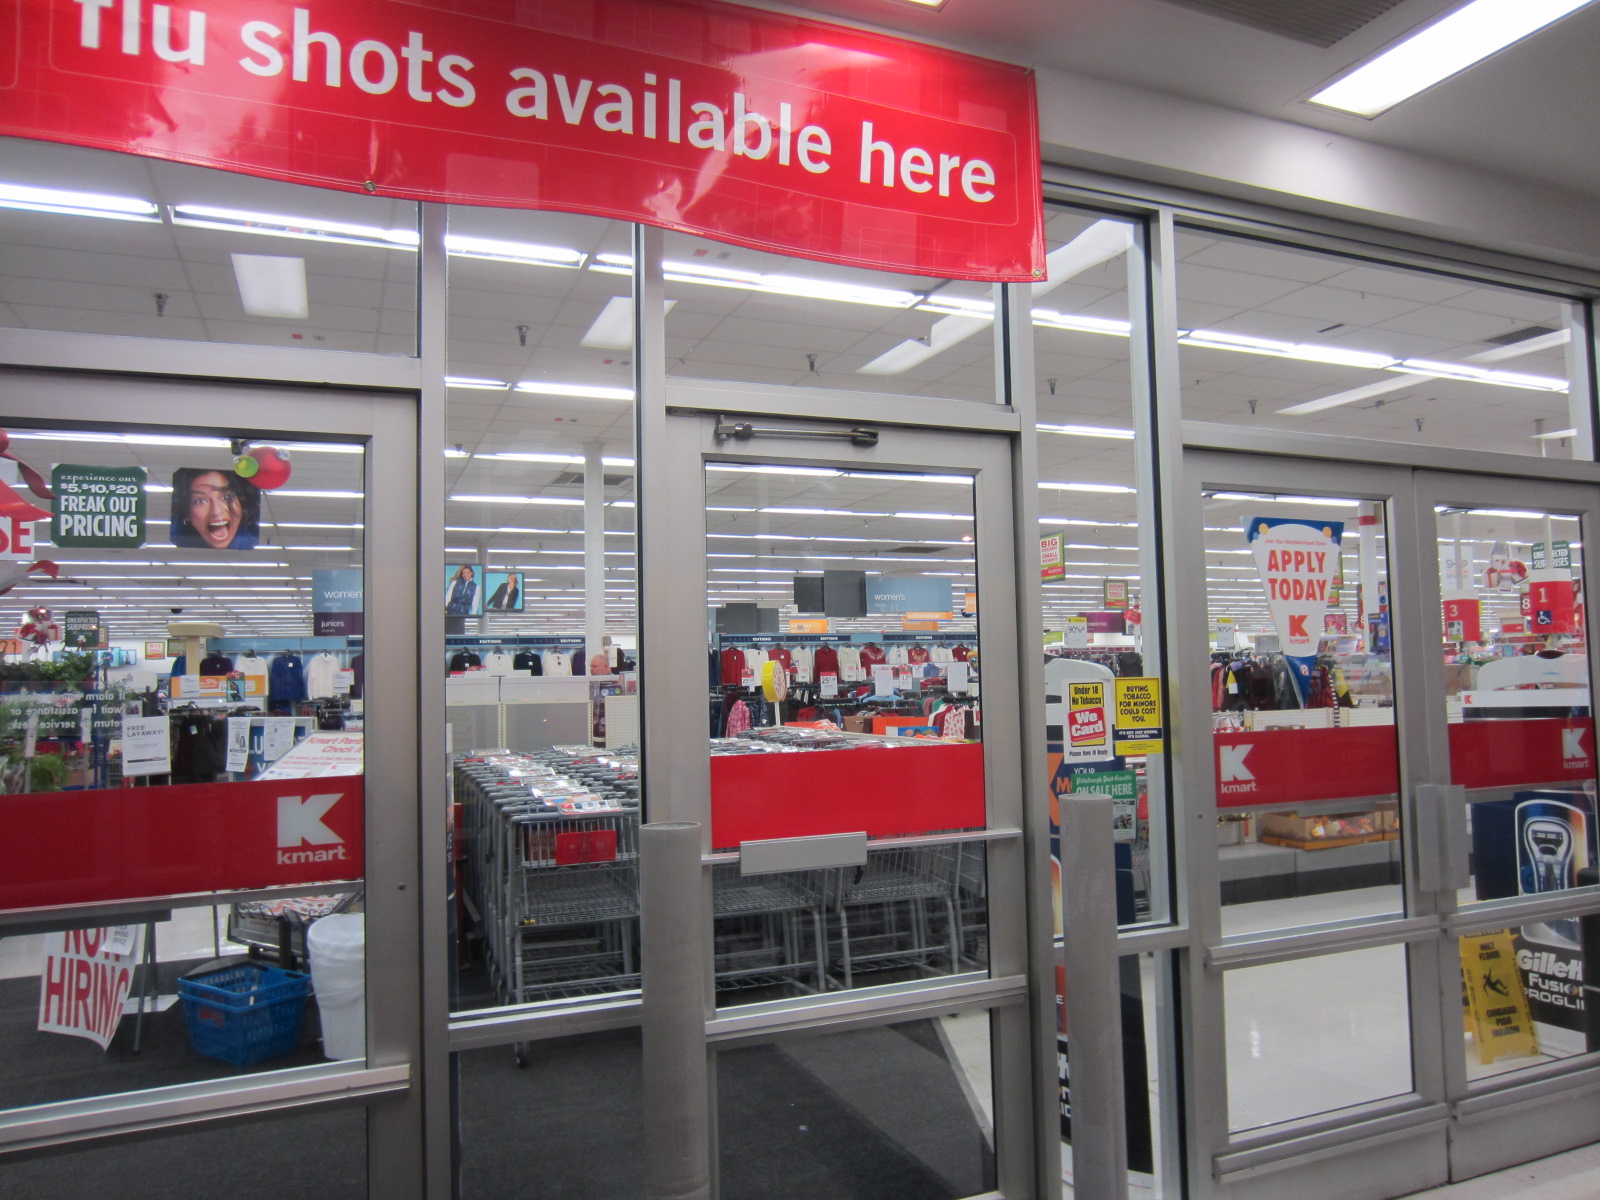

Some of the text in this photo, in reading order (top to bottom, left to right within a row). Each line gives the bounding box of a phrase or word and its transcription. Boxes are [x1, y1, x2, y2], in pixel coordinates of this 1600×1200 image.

[73, 0, 996, 204] flu shots available here
[61, 473, 115, 484] experience
[60, 495, 138, 513] FREAK OUT
[60, 515, 138, 537] PRICING
[1041, 538, 1058, 548] BIG
[1533, 549, 1568, 560] UNEECTED
[1267, 549, 1327, 574] APPLY
[1445, 559, 1468, 568] SHP
[1534, 557, 1569, 569] SURRISES
[1267, 577, 1327, 601] TODAY
[1538, 587, 1549, 603] 1
[874, 592, 906, 601] women's
[1521, 598, 1531, 610] 8
[1449, 604, 1458, 617] 3
[320, 619, 345, 629] juniors
[1288, 614, 1310, 637] K
[1073, 685, 1099, 695] Under 18
[1126, 685, 1149, 693] BUYING
[1071, 696, 1102, 706] No Tobacco
[1074, 711, 1099, 724] We
[1120, 707, 1156, 716] COULD COST
[1131, 715, 1146, 723] YOU.
[1071, 720, 1104, 737] Card
[306, 736, 338, 745] Kmart
[1561, 727, 1588, 760] K
[321, 744, 352, 753] Check
[1219, 743, 1256, 782] K
[1563, 759, 1590, 769] kmart
[1076, 774, 1133, 786] Pittsburgh Post-Gazette
[1076, 783, 1133, 796] ON SALE HERE
[1221, 781, 1257, 794] kmart
[277, 793, 345, 848] K
[277, 846, 346, 865] kmart
[1479, 942, 1495, 951] WET
[1479, 950, 1501, 961] FLOOR
[43, 955, 130, 1041] HIRING
[1486, 1005, 1517, 1018] CUIDADO
[1495, 1017, 1512, 1027] PISO
